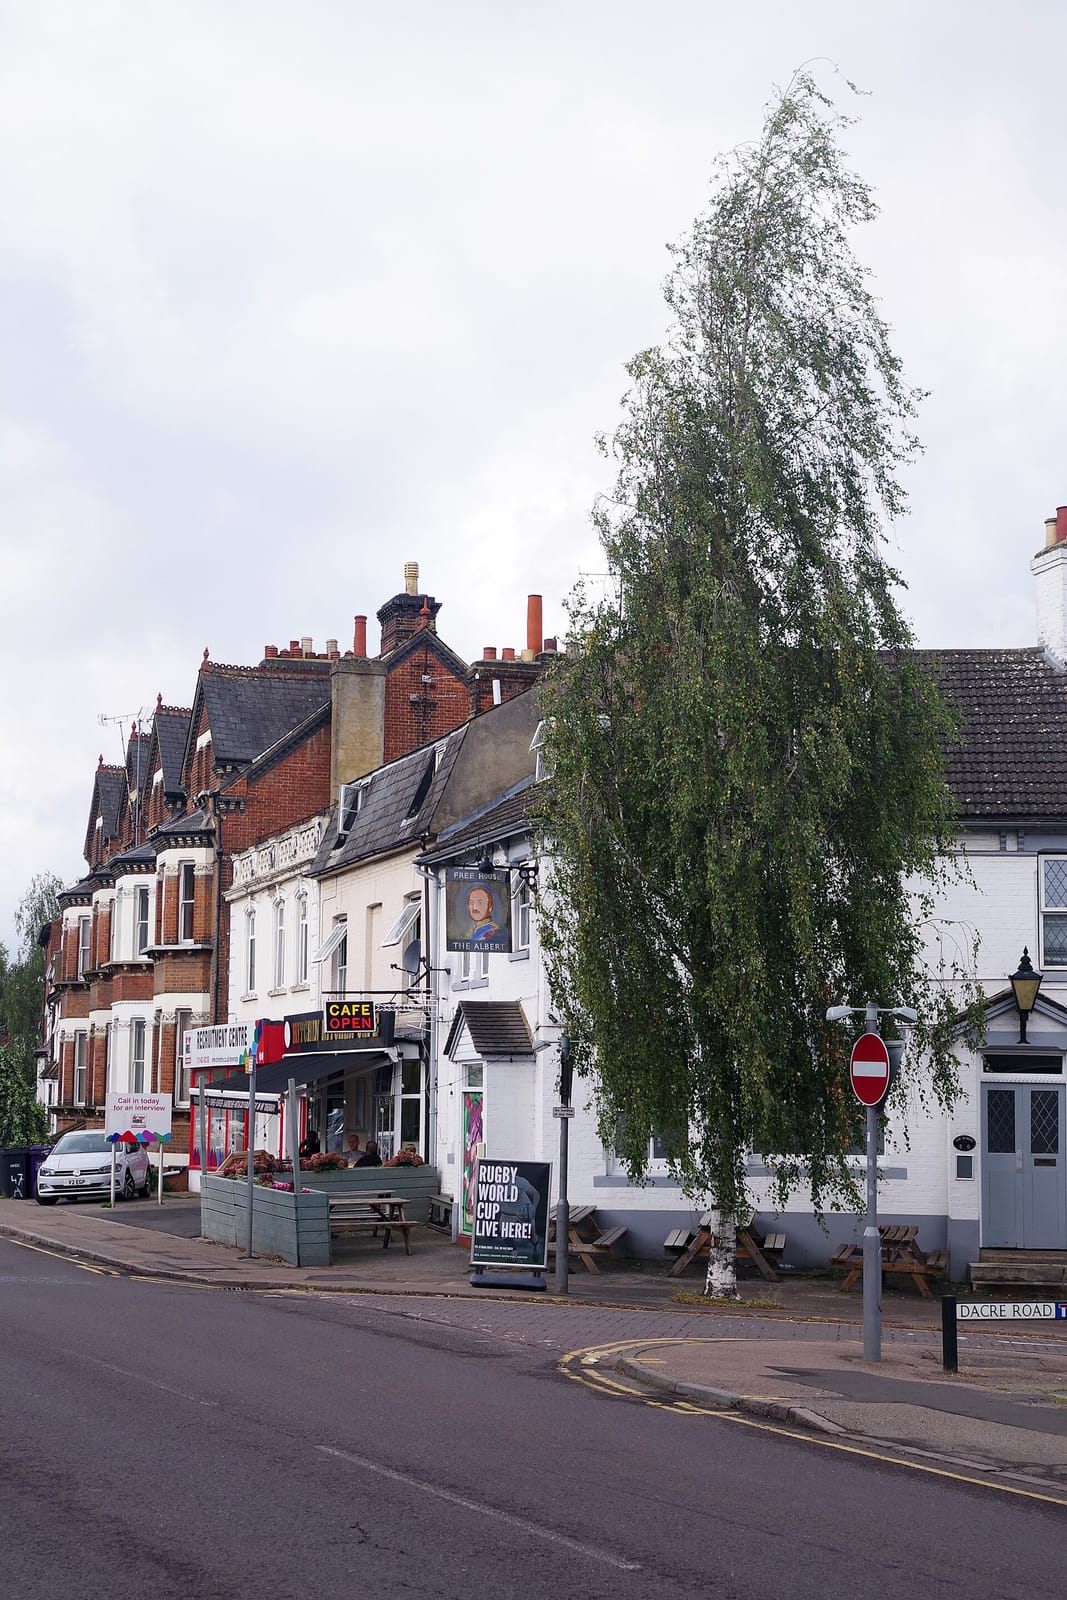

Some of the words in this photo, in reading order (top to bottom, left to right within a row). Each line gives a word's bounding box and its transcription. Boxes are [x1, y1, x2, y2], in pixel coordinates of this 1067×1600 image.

[453, 872, 475, 880] FREE
[478, 872, 502, 880] HOUSE
[453, 942, 471, 950] THE
[329, 1004, 371, 1016] CAFE
[329, 1018, 372, 1029] OPEN
[196, 1028, 228, 1050] RECRUITMENT
[228, 1025, 248, 1048] CENTRE
[140, 1097, 160, 1105] today
[10, 1173, 25, 1186] 47
[480, 1165, 518, 1184] RUGBY
[478, 1183, 519, 1203] WORLD
[477, 1202, 500, 1220] CUP
[476, 1220, 499, 1237] LIVE
[501, 1221, 532, 1239] HERE!
[960, 1304, 1006, 1318] DACRE
[1012, 1304, 1053, 1317] ROAD
